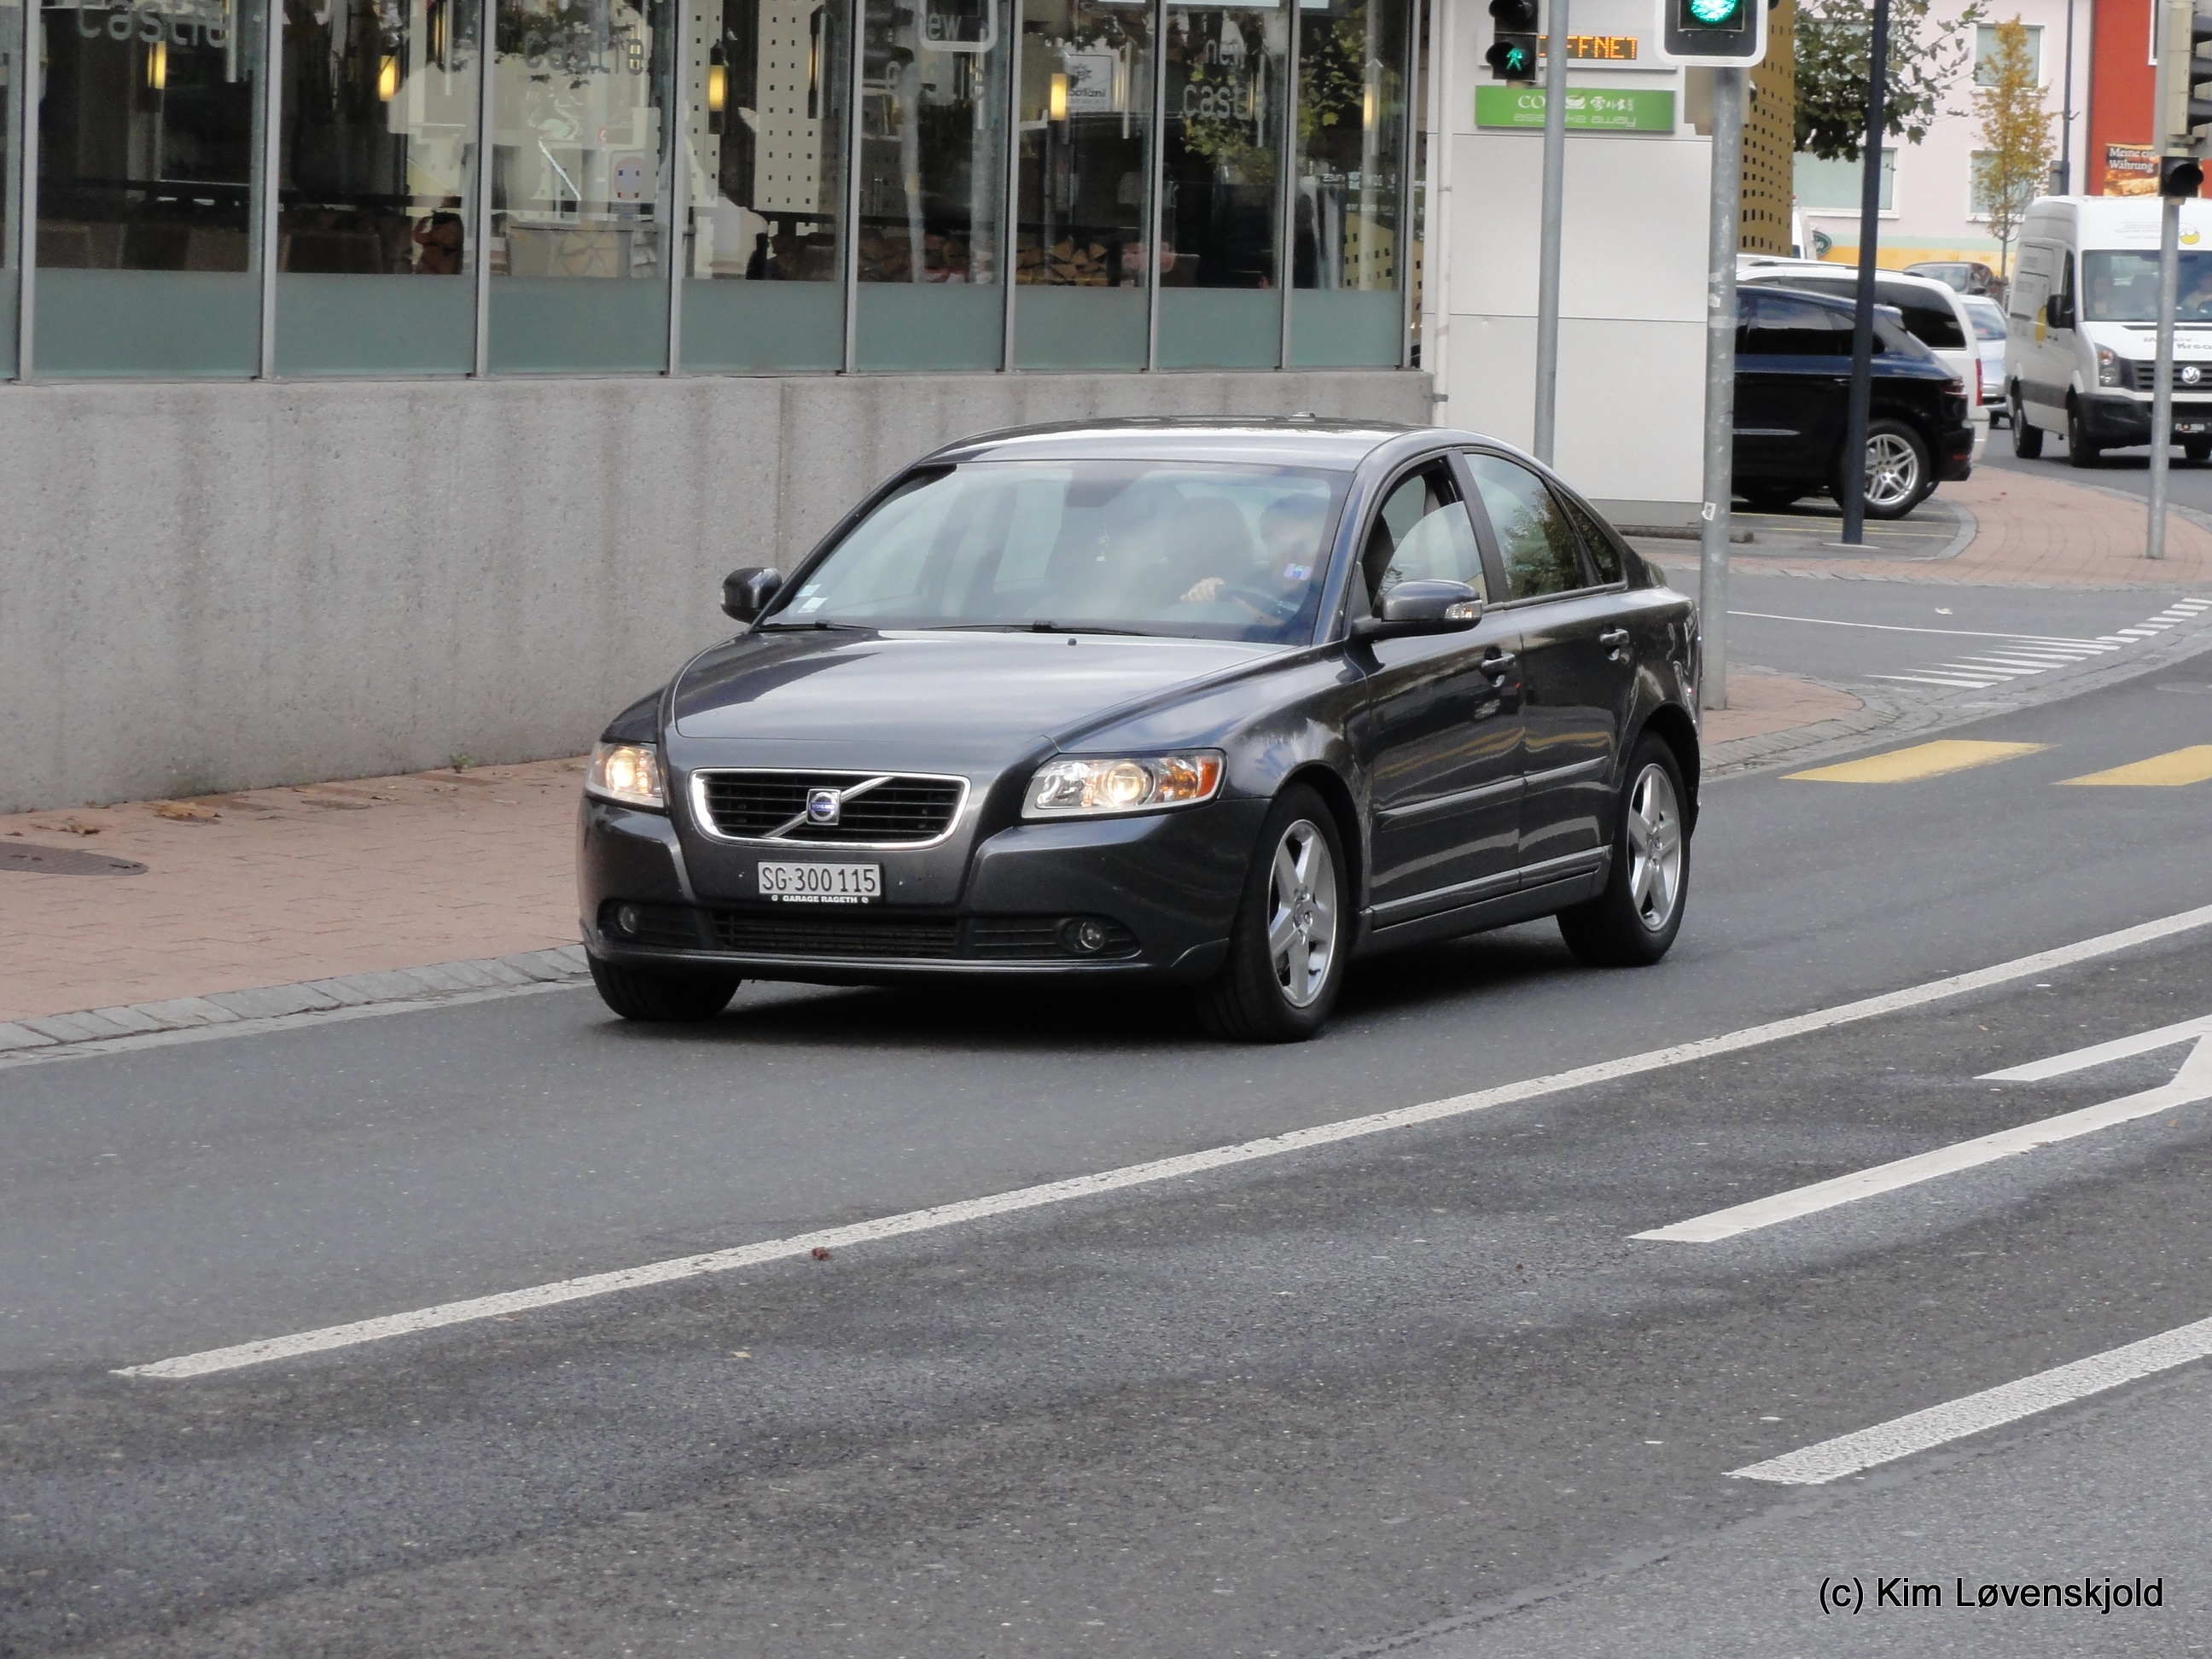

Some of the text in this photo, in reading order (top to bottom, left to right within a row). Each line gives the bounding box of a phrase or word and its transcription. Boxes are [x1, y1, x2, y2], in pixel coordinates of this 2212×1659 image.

[1517, 95, 1546, 109] CO
[1591, 114, 1637, 127] away
[2109, 147, 2140, 158] Meine
[2109, 159, 2154, 173] Währung
